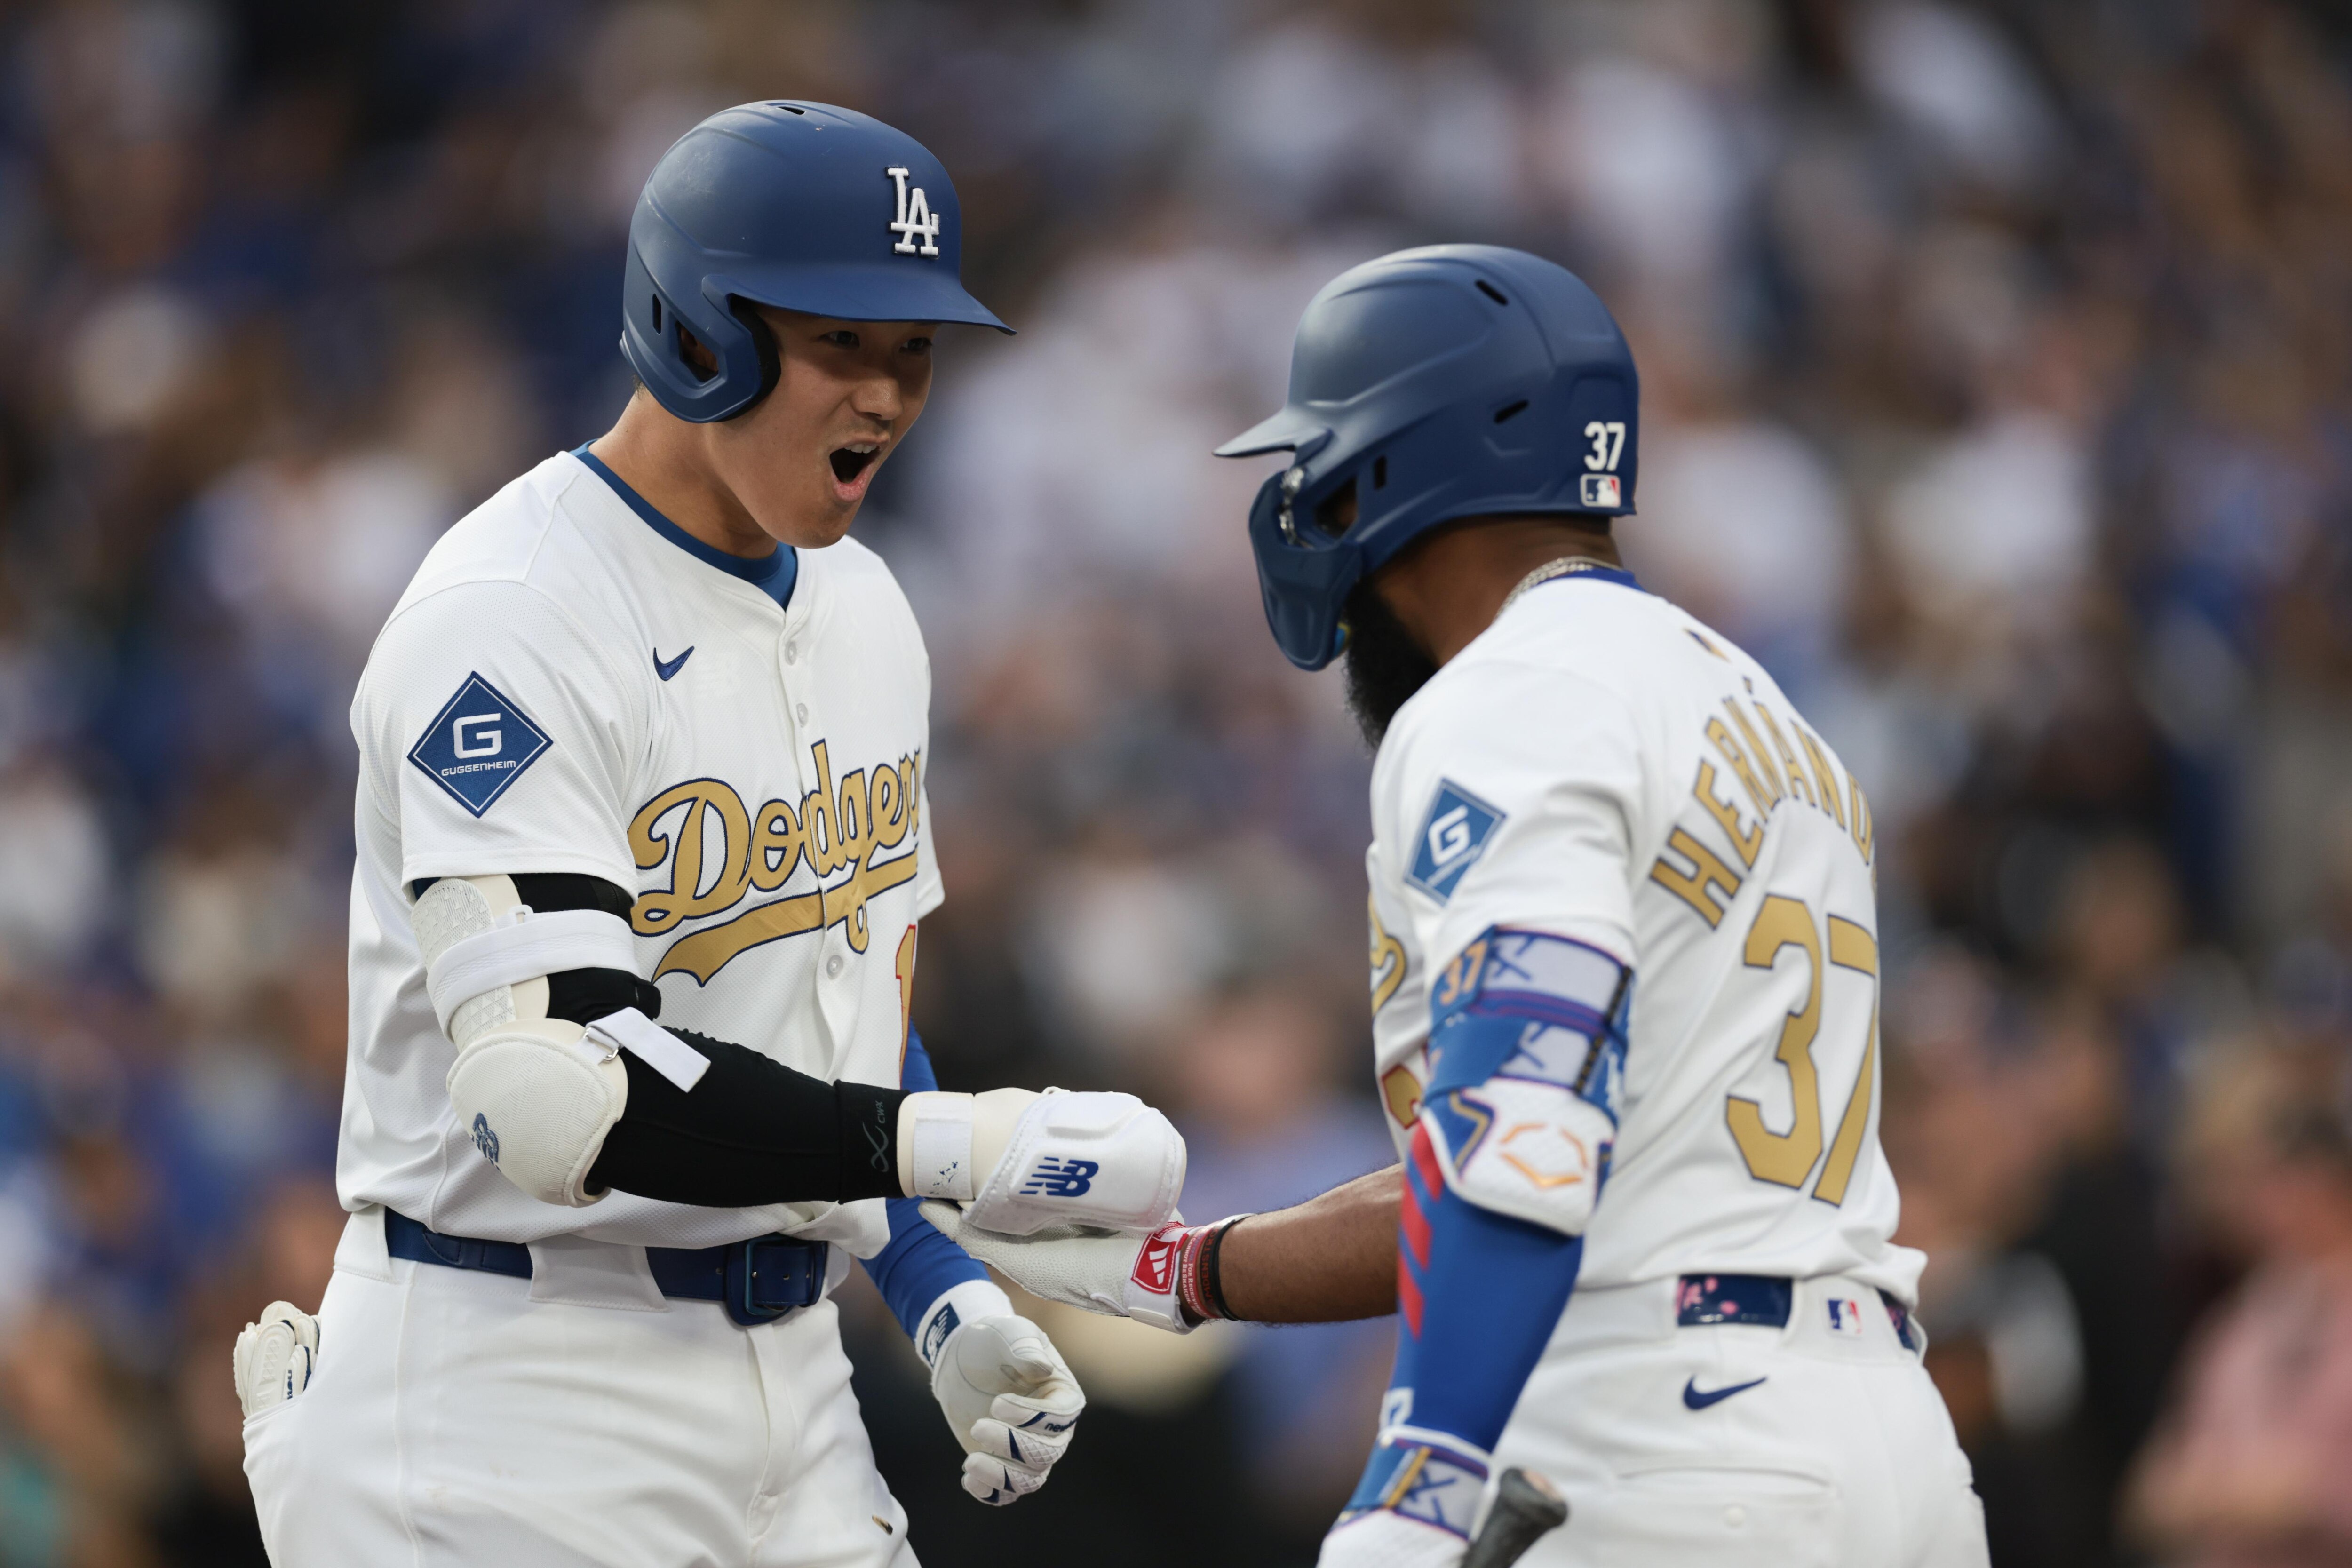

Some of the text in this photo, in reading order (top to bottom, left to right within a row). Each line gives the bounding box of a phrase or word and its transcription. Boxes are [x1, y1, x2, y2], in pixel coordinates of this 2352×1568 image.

[886, 167, 939, 256] LA
[1583, 421, 1626, 472] 37
[452, 712, 502, 759] G
[441, 760, 517, 777] GUGGENHEIM
[1648, 675, 1874, 931] HERNÁND
[627, 738, 920, 955] Dodger
[1428, 804, 1470, 867] G
[1724, 893, 1877, 1209] 37
[1182, 1264, 1188, 1273] BE
